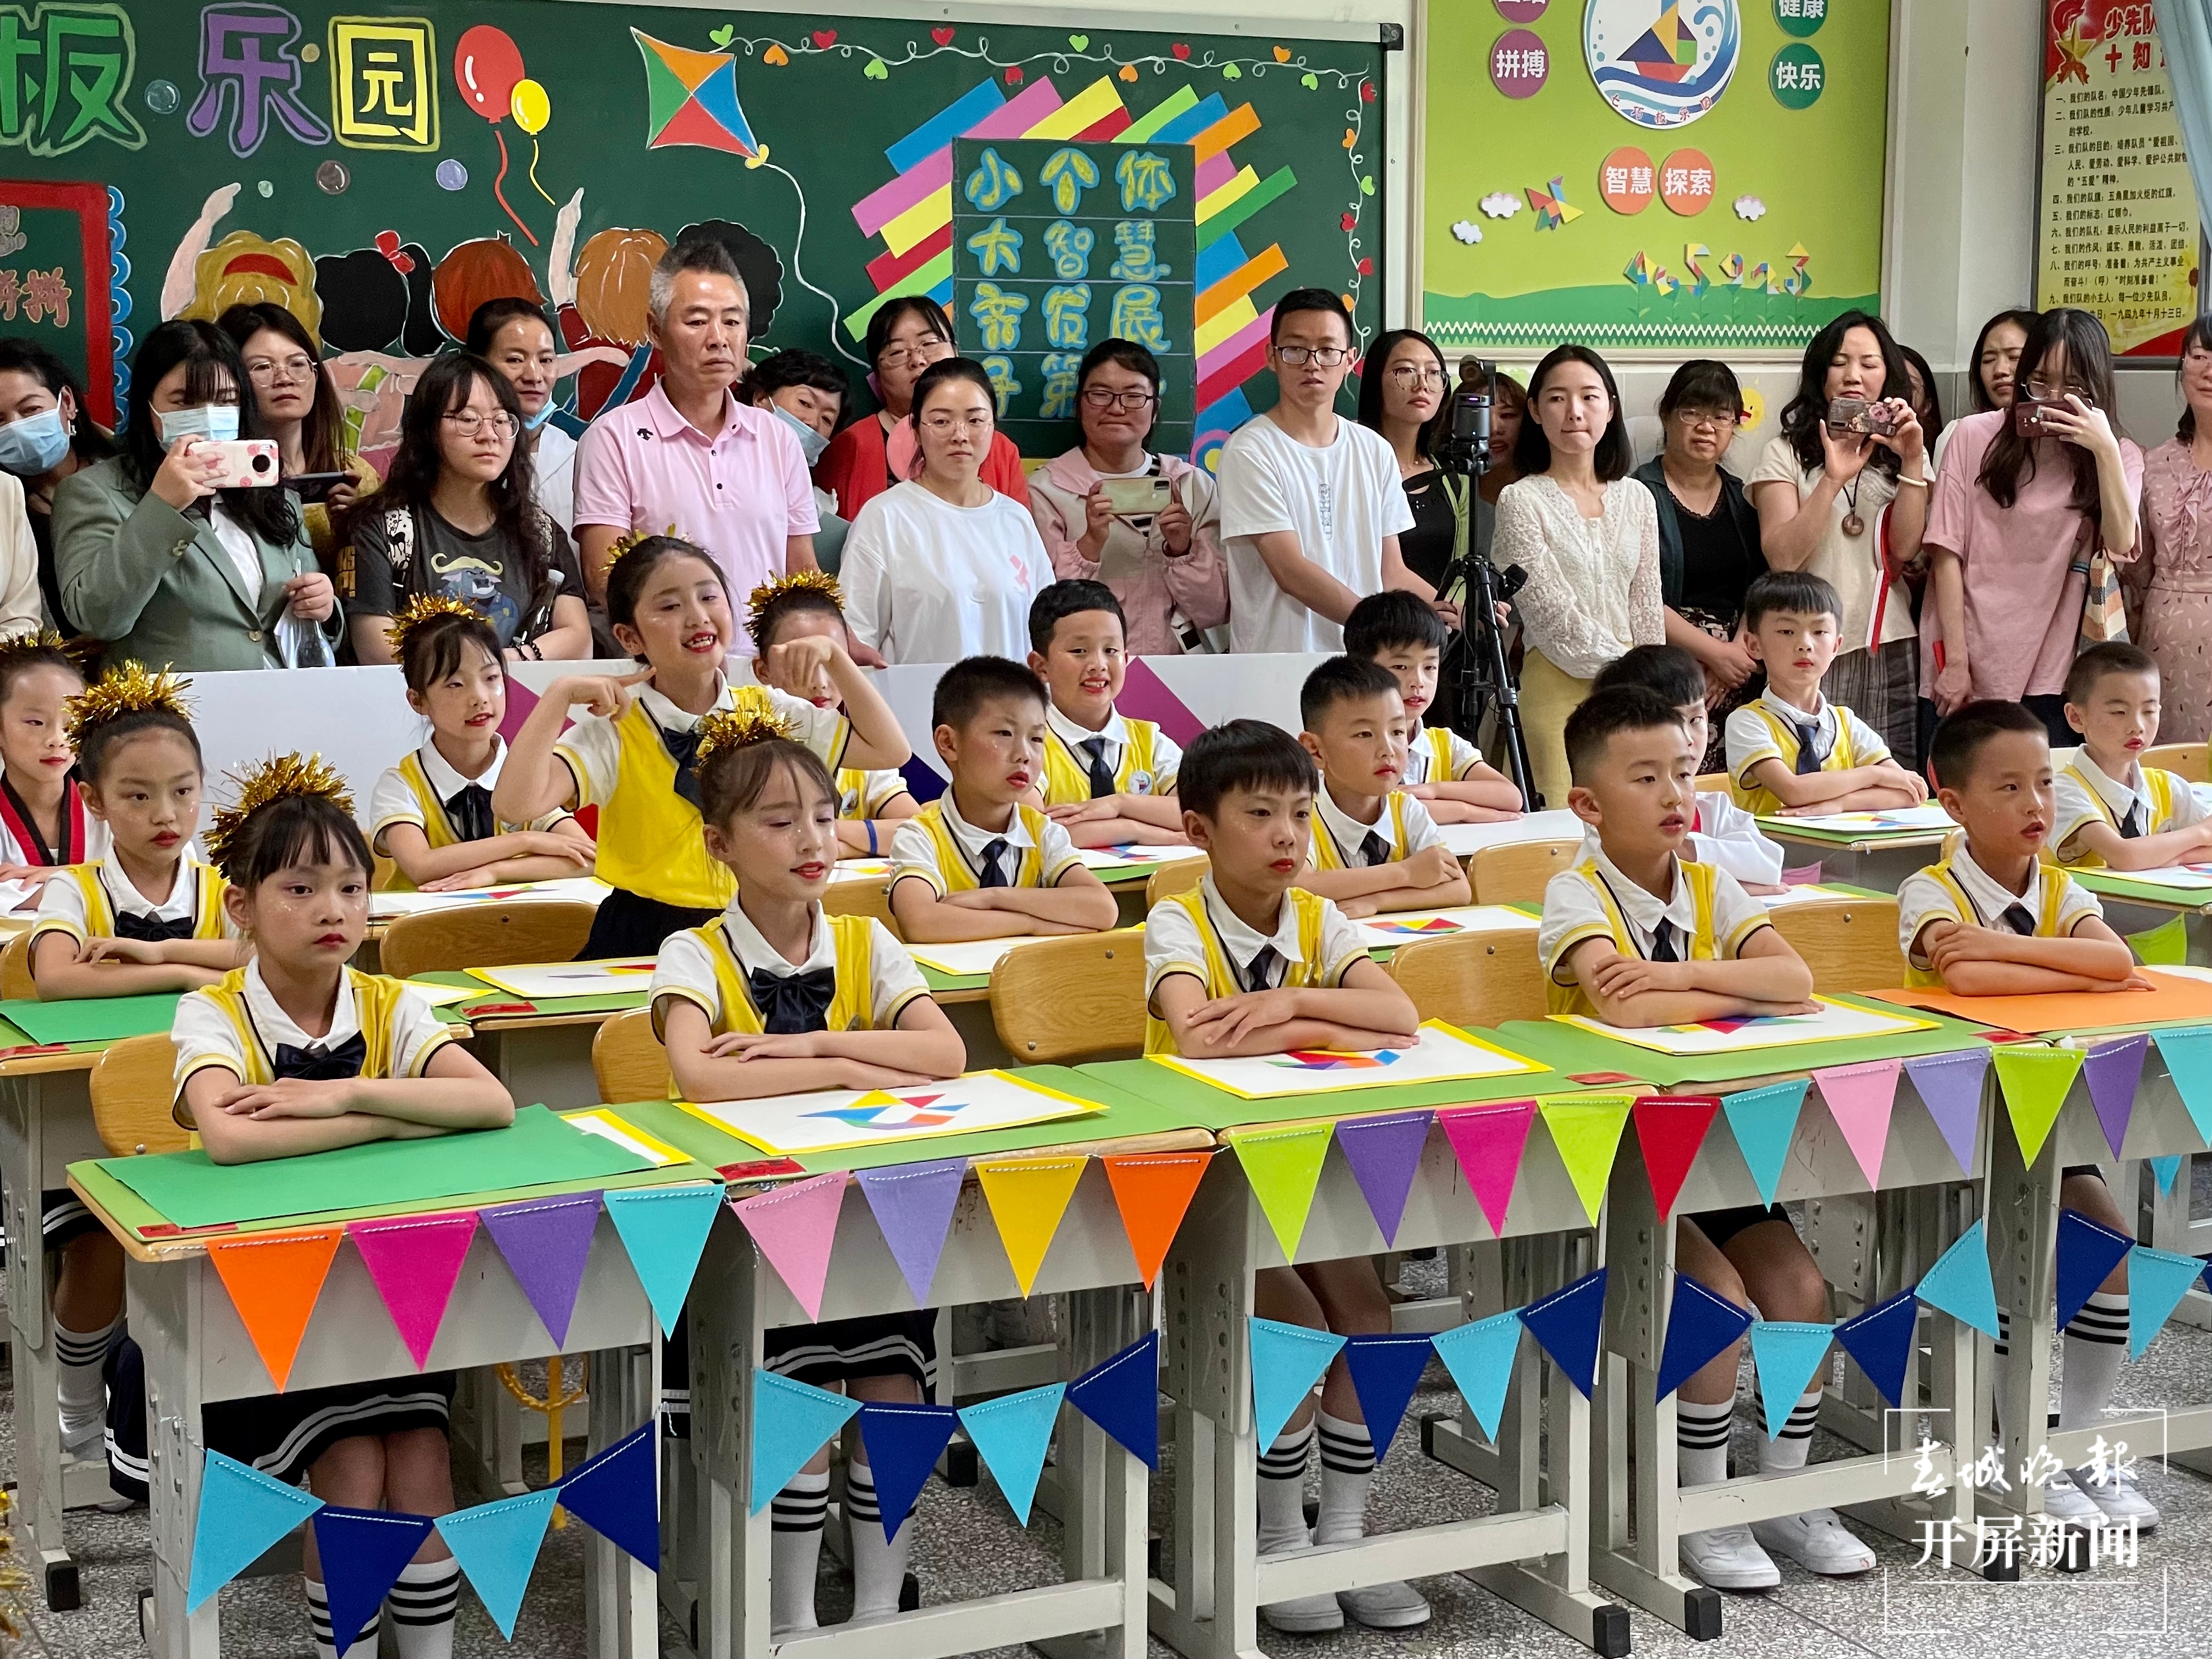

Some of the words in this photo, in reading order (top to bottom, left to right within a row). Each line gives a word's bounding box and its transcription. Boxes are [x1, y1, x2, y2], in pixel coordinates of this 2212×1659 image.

[1778, 0, 1825, 18] 健康
[1496, 49, 1545, 78] 拼搏
[2104, 41, 2166, 73] 十知
[1776, 62, 1821, 90] 快乐
[965, 147, 1176, 216] 小个体
[1606, 166, 1652, 194] 智慧
[1665, 168, 1712, 196] 探索
[966, 218, 1172, 282] 大智慧
